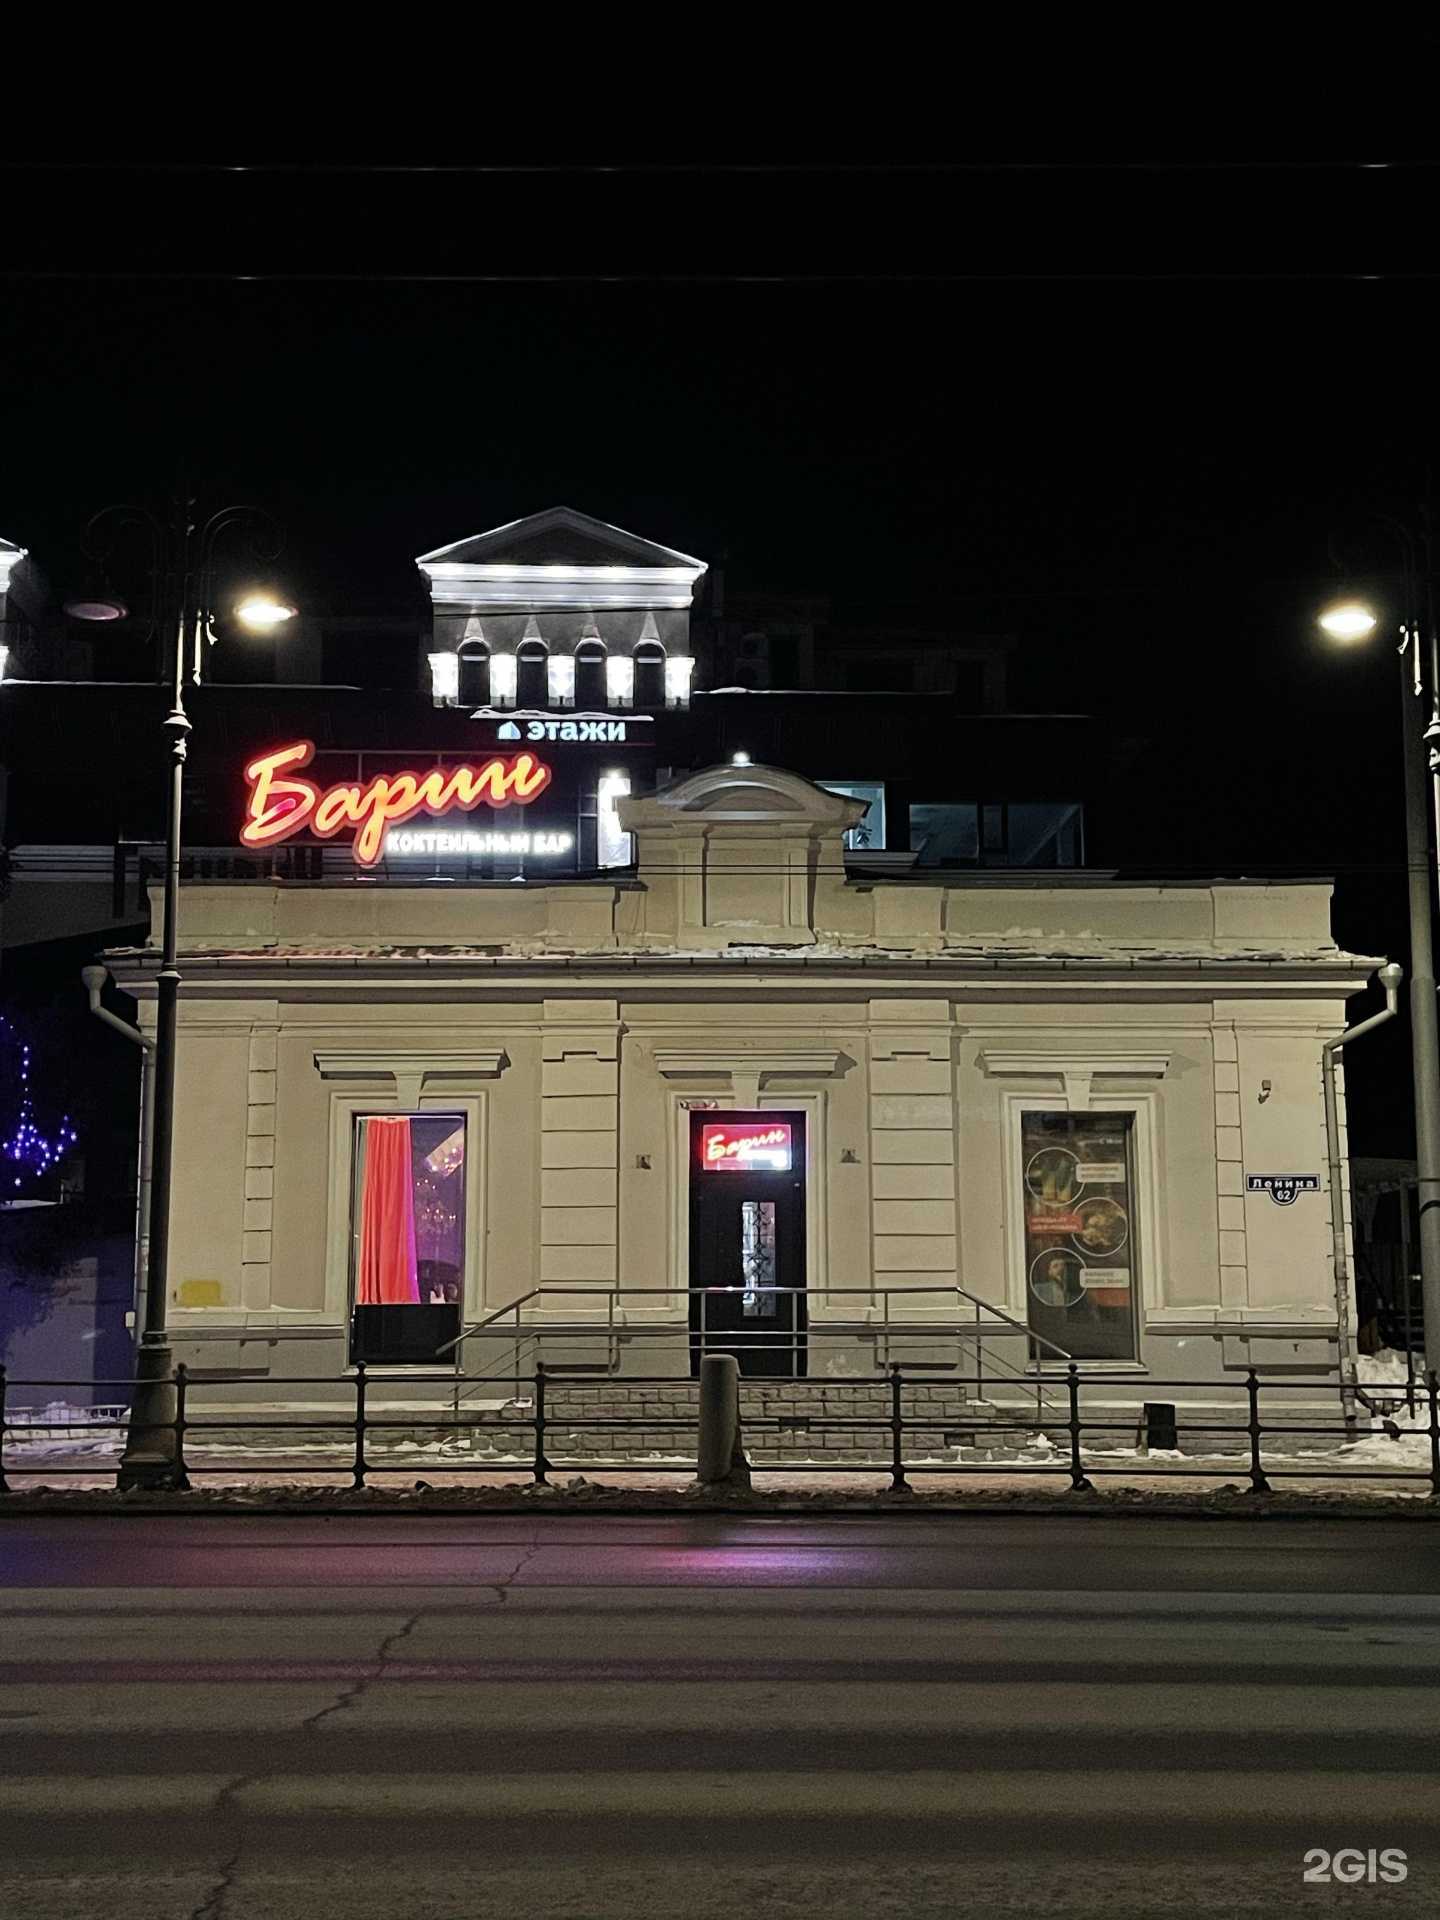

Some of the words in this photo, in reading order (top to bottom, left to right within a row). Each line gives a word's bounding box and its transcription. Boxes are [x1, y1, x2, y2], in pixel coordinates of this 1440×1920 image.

[526, 720, 627, 742] этажи
[242, 742, 549, 864] Барин
[533, 833, 574, 854] БАР
[706, 1129, 787, 1162] Барин
[1252, 1178, 1315, 1188] Ленина
[1276, 1190, 1291, 1200] 62
